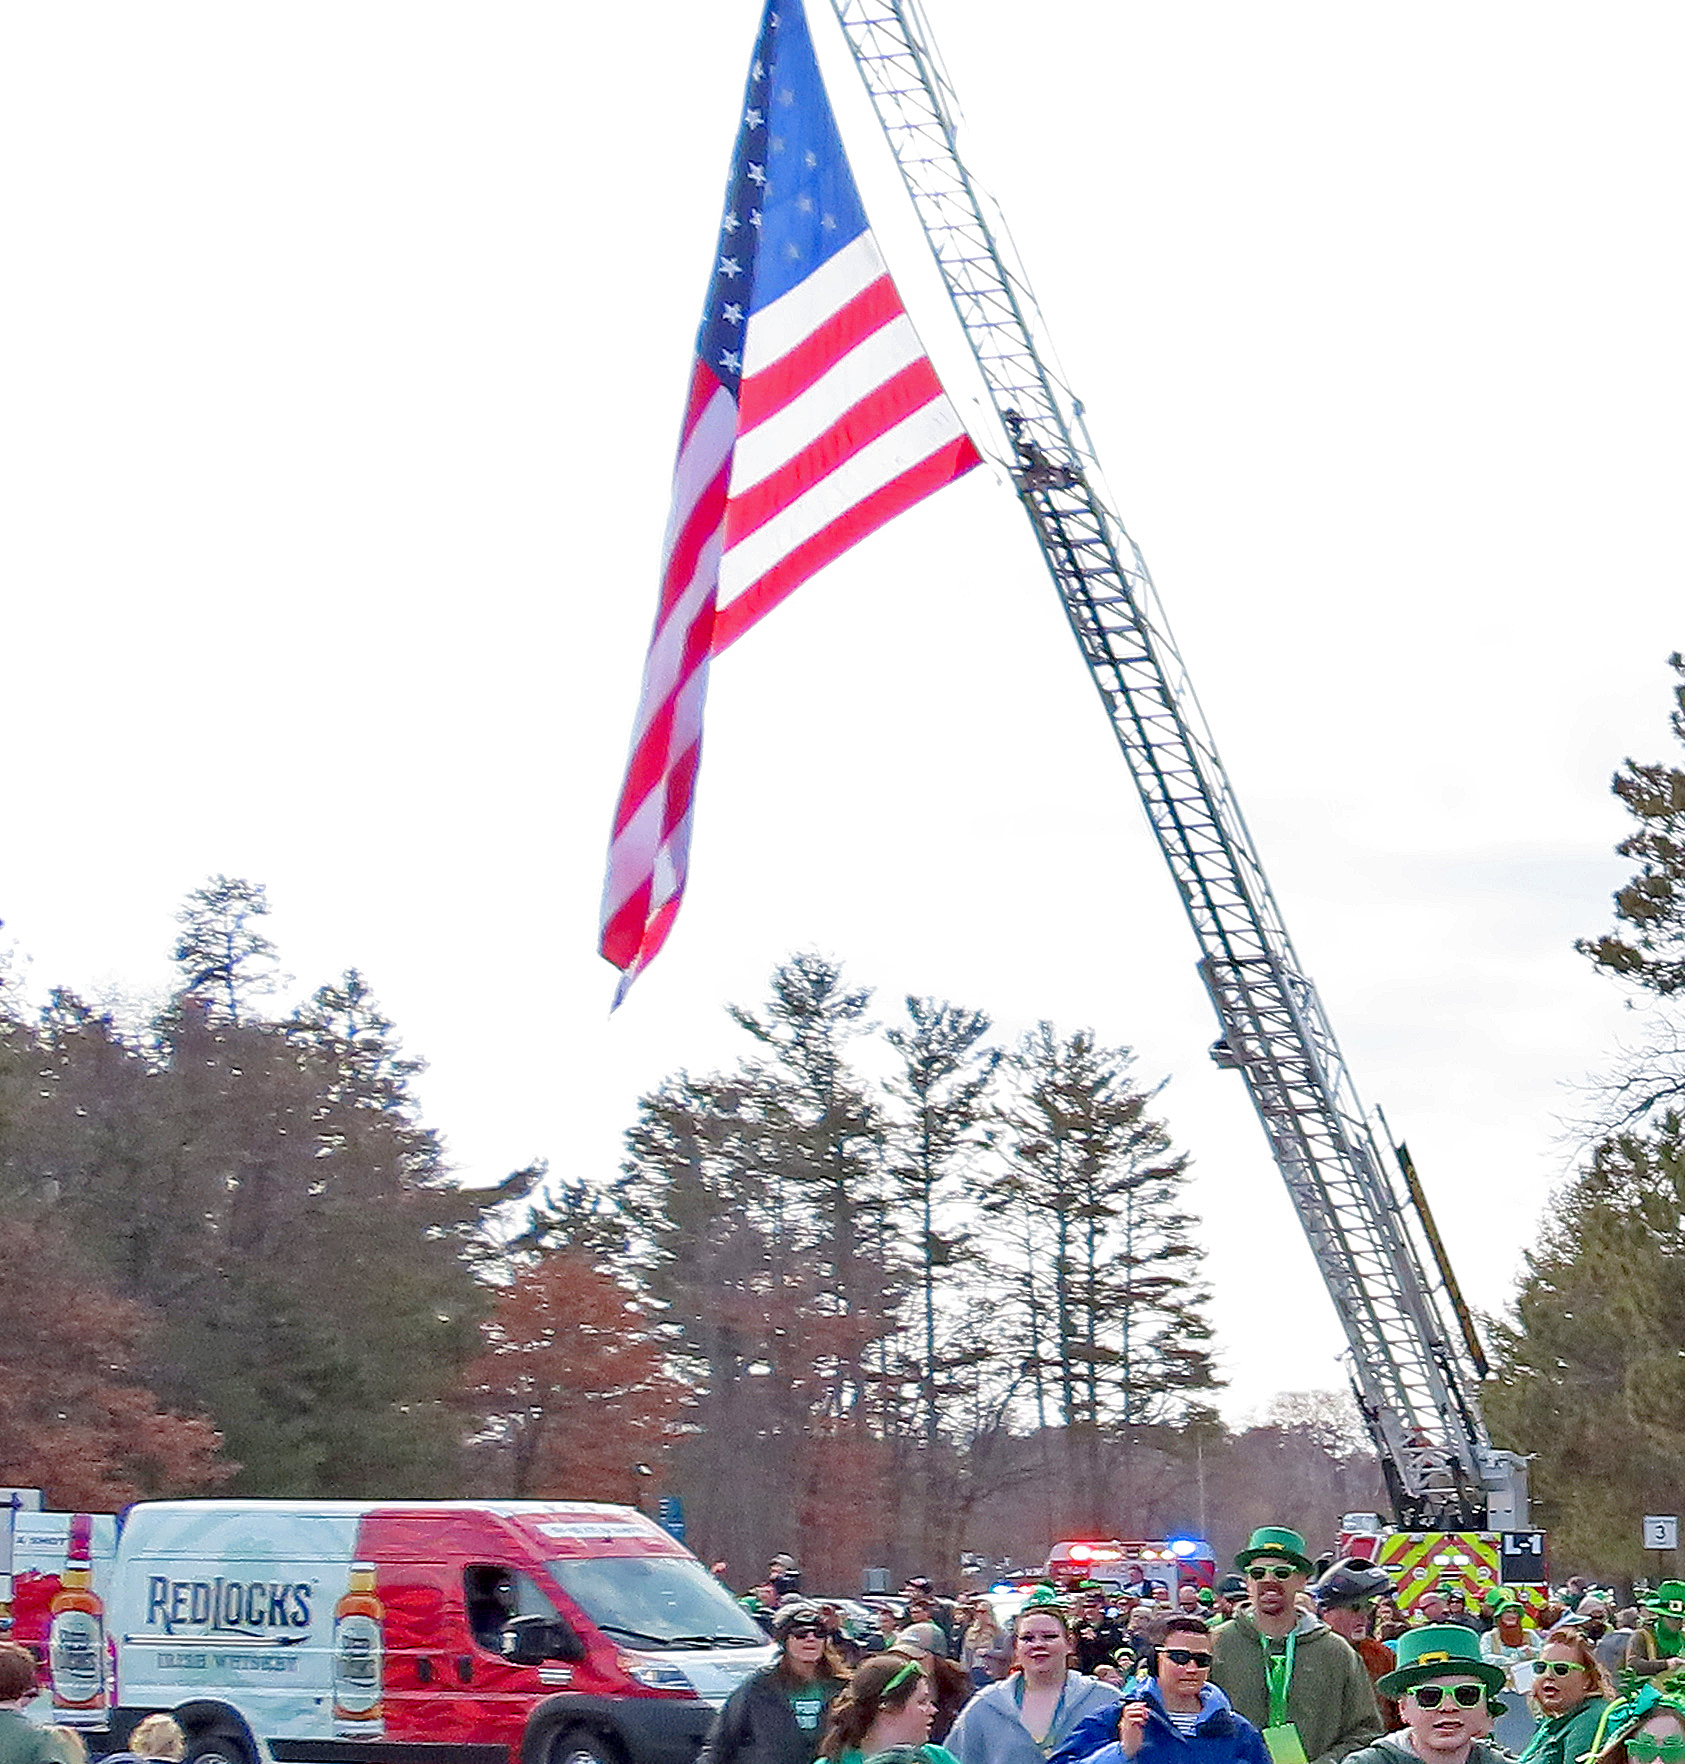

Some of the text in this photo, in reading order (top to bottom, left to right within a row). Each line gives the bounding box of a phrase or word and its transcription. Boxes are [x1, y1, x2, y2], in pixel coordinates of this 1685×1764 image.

[1655, 1525, 1666, 1540] 3
[1505, 1534, 1542, 1555] L-1
[146, 1576, 313, 1635] REDLOCKS
